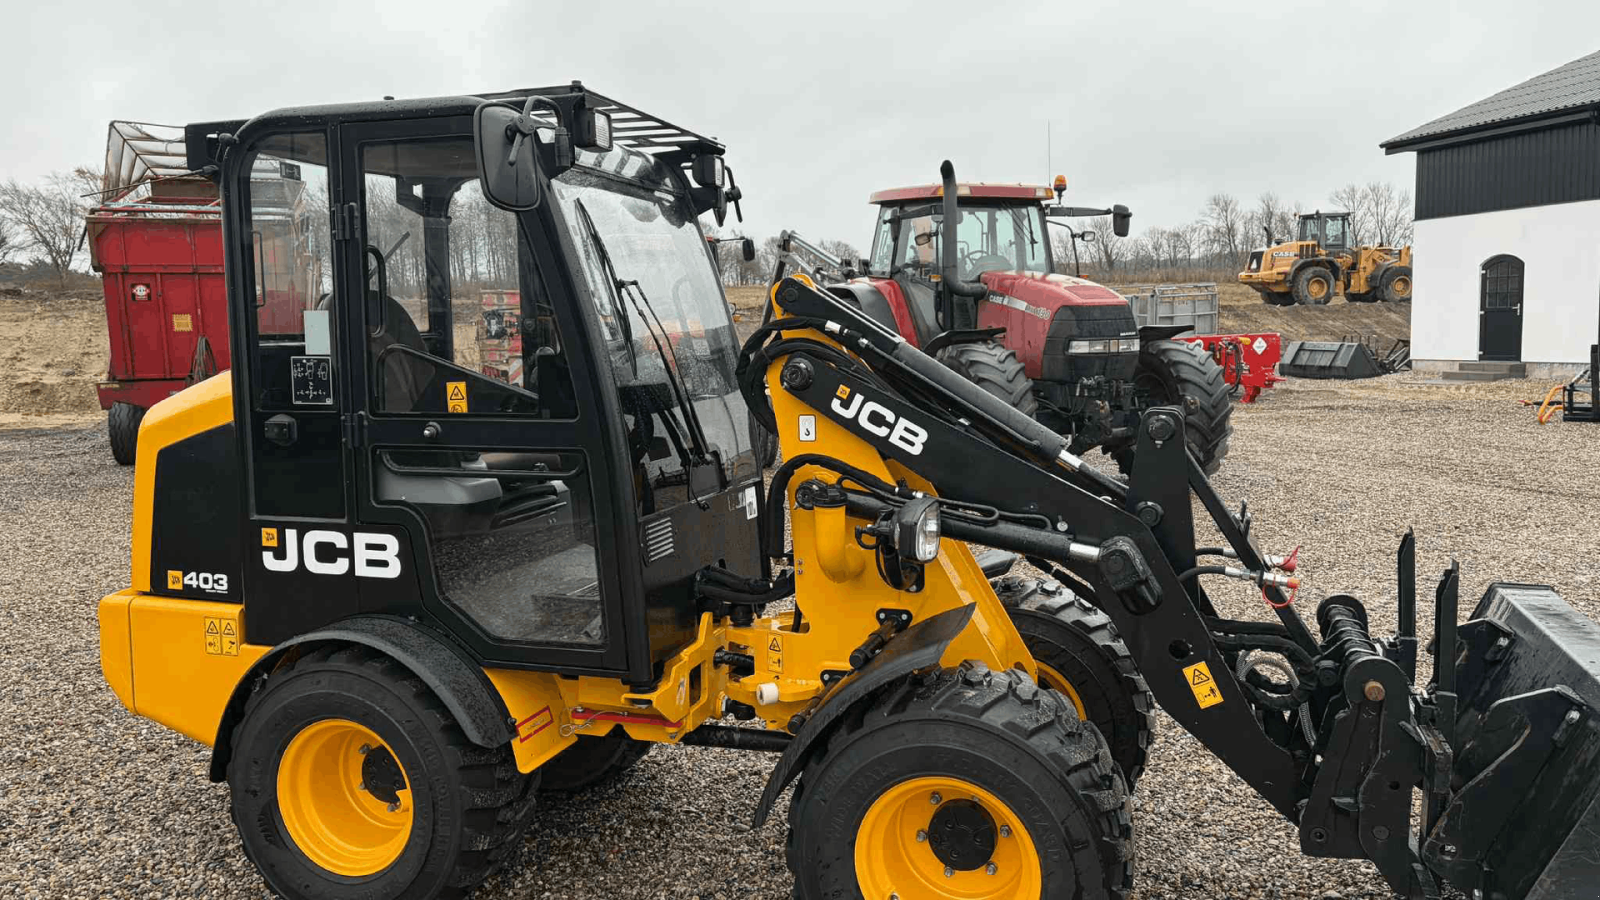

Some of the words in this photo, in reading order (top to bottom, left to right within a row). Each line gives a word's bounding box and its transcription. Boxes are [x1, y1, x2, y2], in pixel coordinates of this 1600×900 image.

[989, 294, 1004, 305] CASE
[831, 393, 928, 456] JCB
[262, 528, 402, 579] JCB
[184, 571, 228, 591] 403
